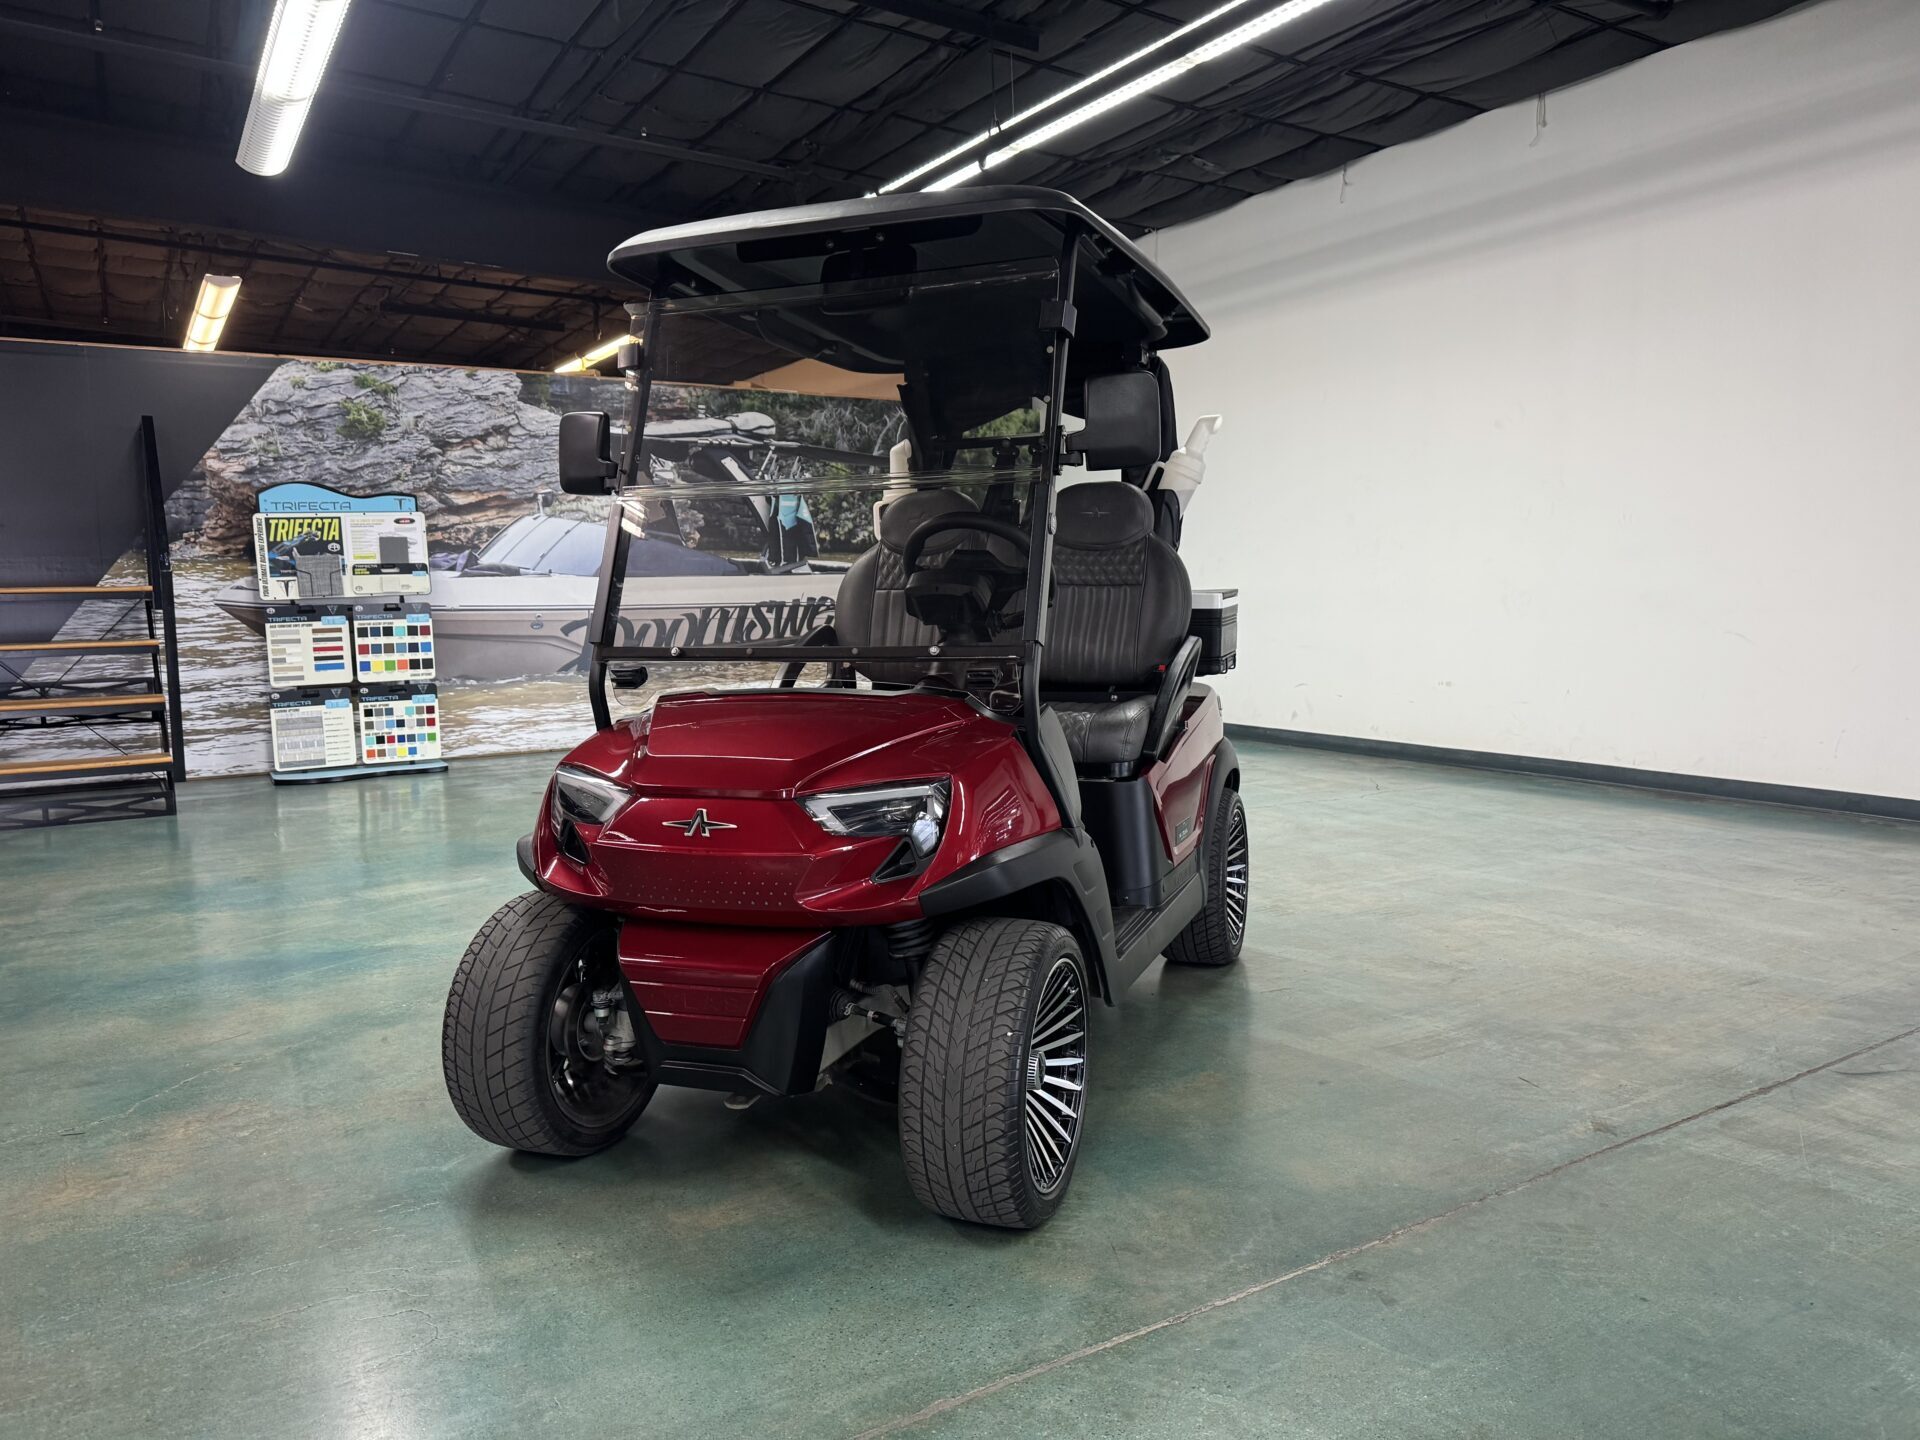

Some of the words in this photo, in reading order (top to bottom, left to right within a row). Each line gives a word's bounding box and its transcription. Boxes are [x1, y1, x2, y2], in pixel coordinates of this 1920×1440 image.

[270, 501, 352, 511] TRIFECTA
[256, 517, 265, 544] EXPERIENCE
[268, 518, 340, 542] TRIFECTA
[258, 544, 267, 563] BOATING
[260, 564, 269, 585] ULTIMATE
